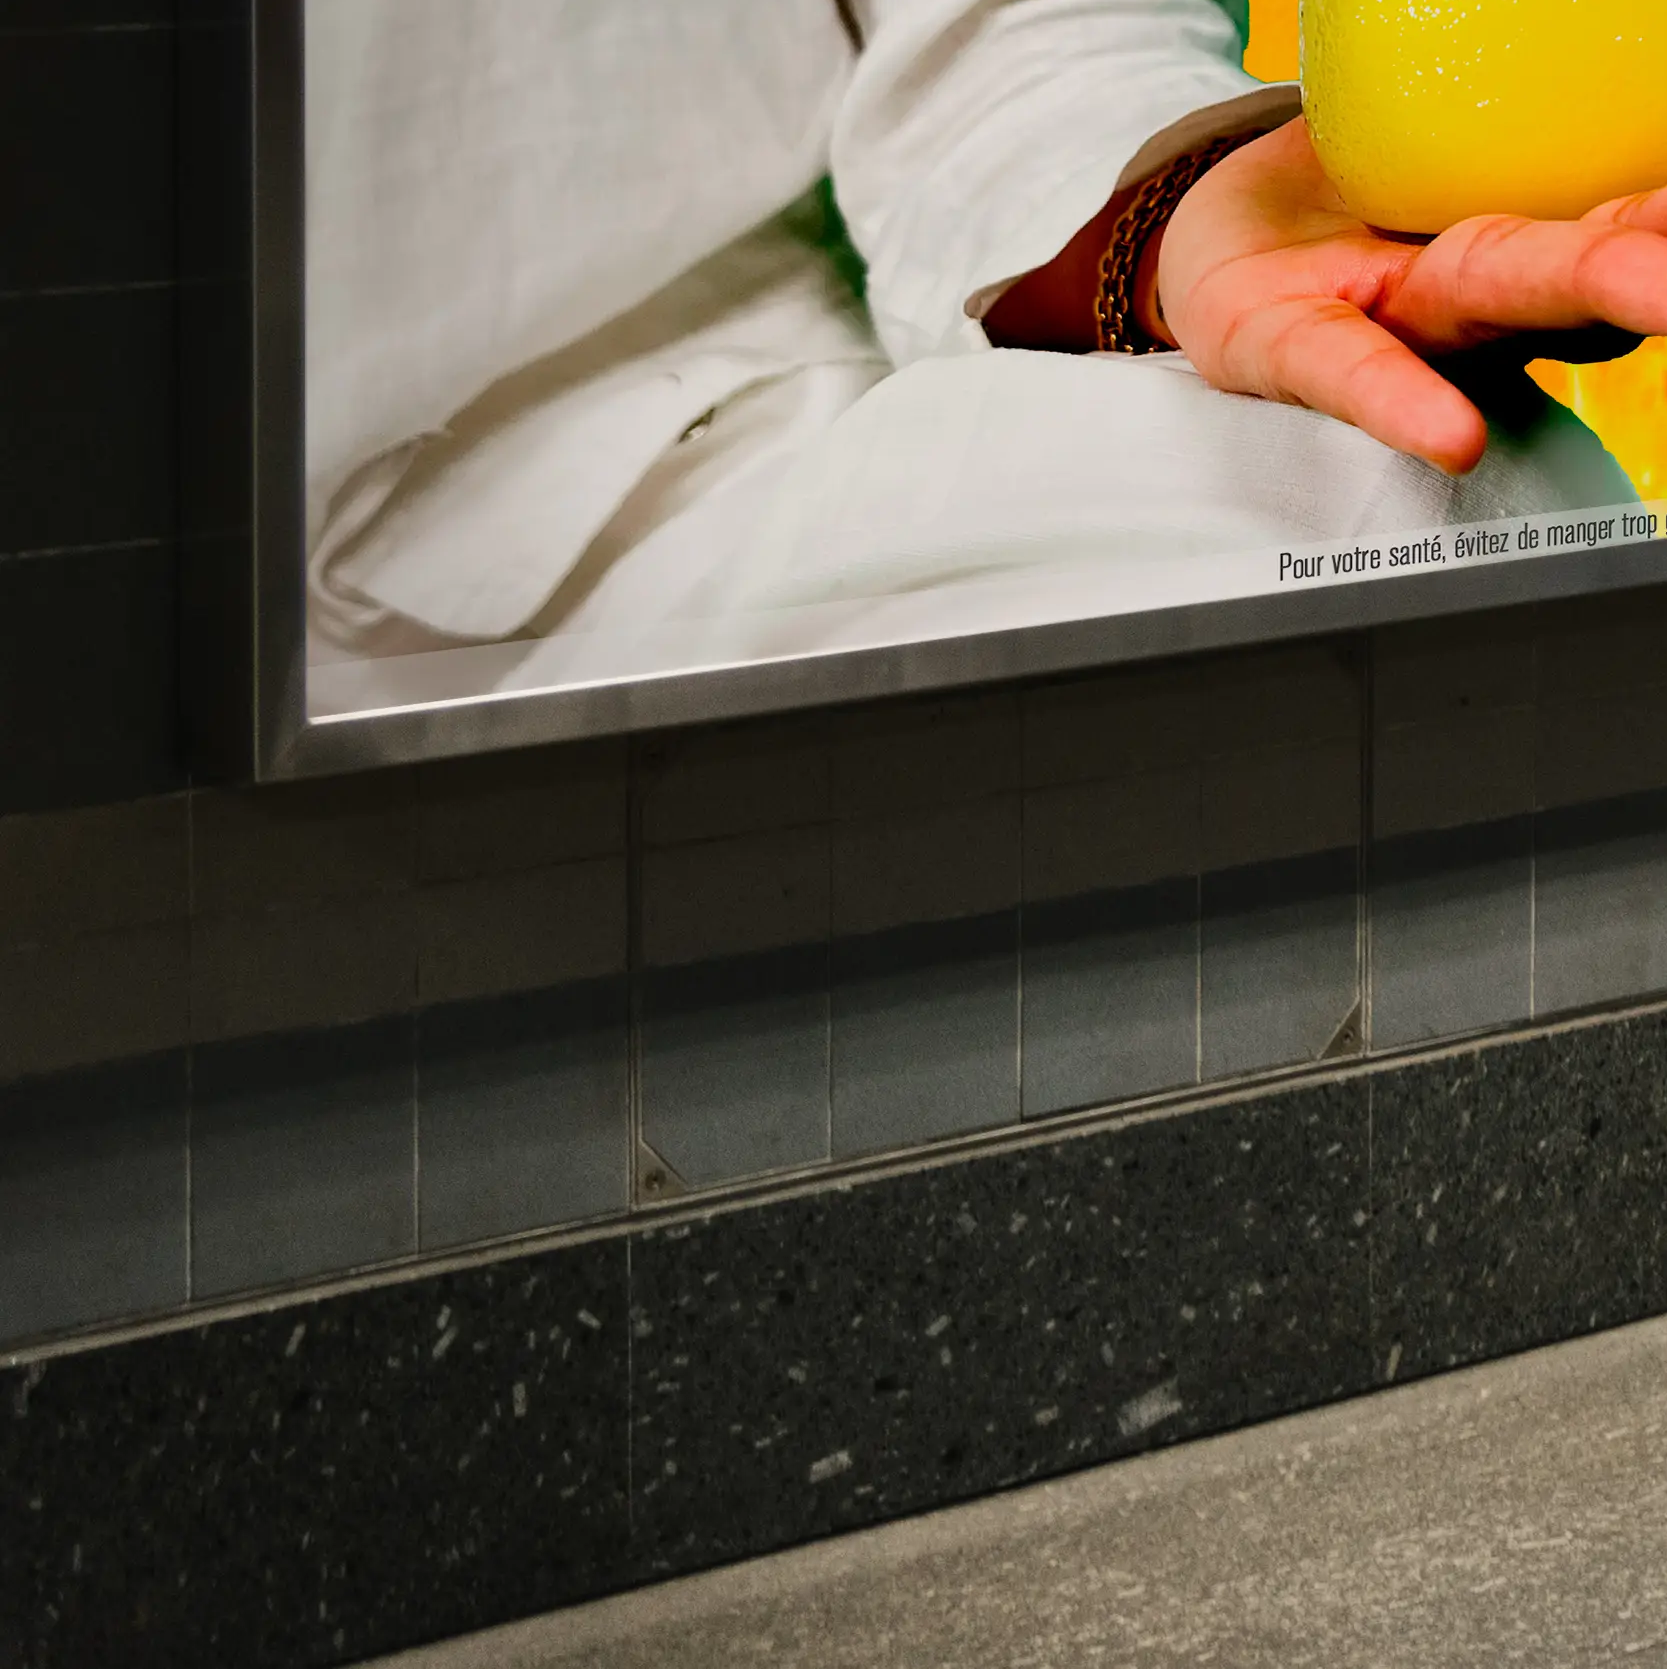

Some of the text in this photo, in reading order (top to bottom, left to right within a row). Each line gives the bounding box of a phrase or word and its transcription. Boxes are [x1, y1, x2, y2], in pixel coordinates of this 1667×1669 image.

[1279, 552, 1325, 581] Pour
[1331, 546, 1381, 574] votre
[1388, 535, 1446, 567] santé,
[1454, 532, 1510, 558] évitez
[1517, 522, 1539, 550] de
[1547, 518, 1616, 547] manger
[1621, 513, 1658, 539] trop
